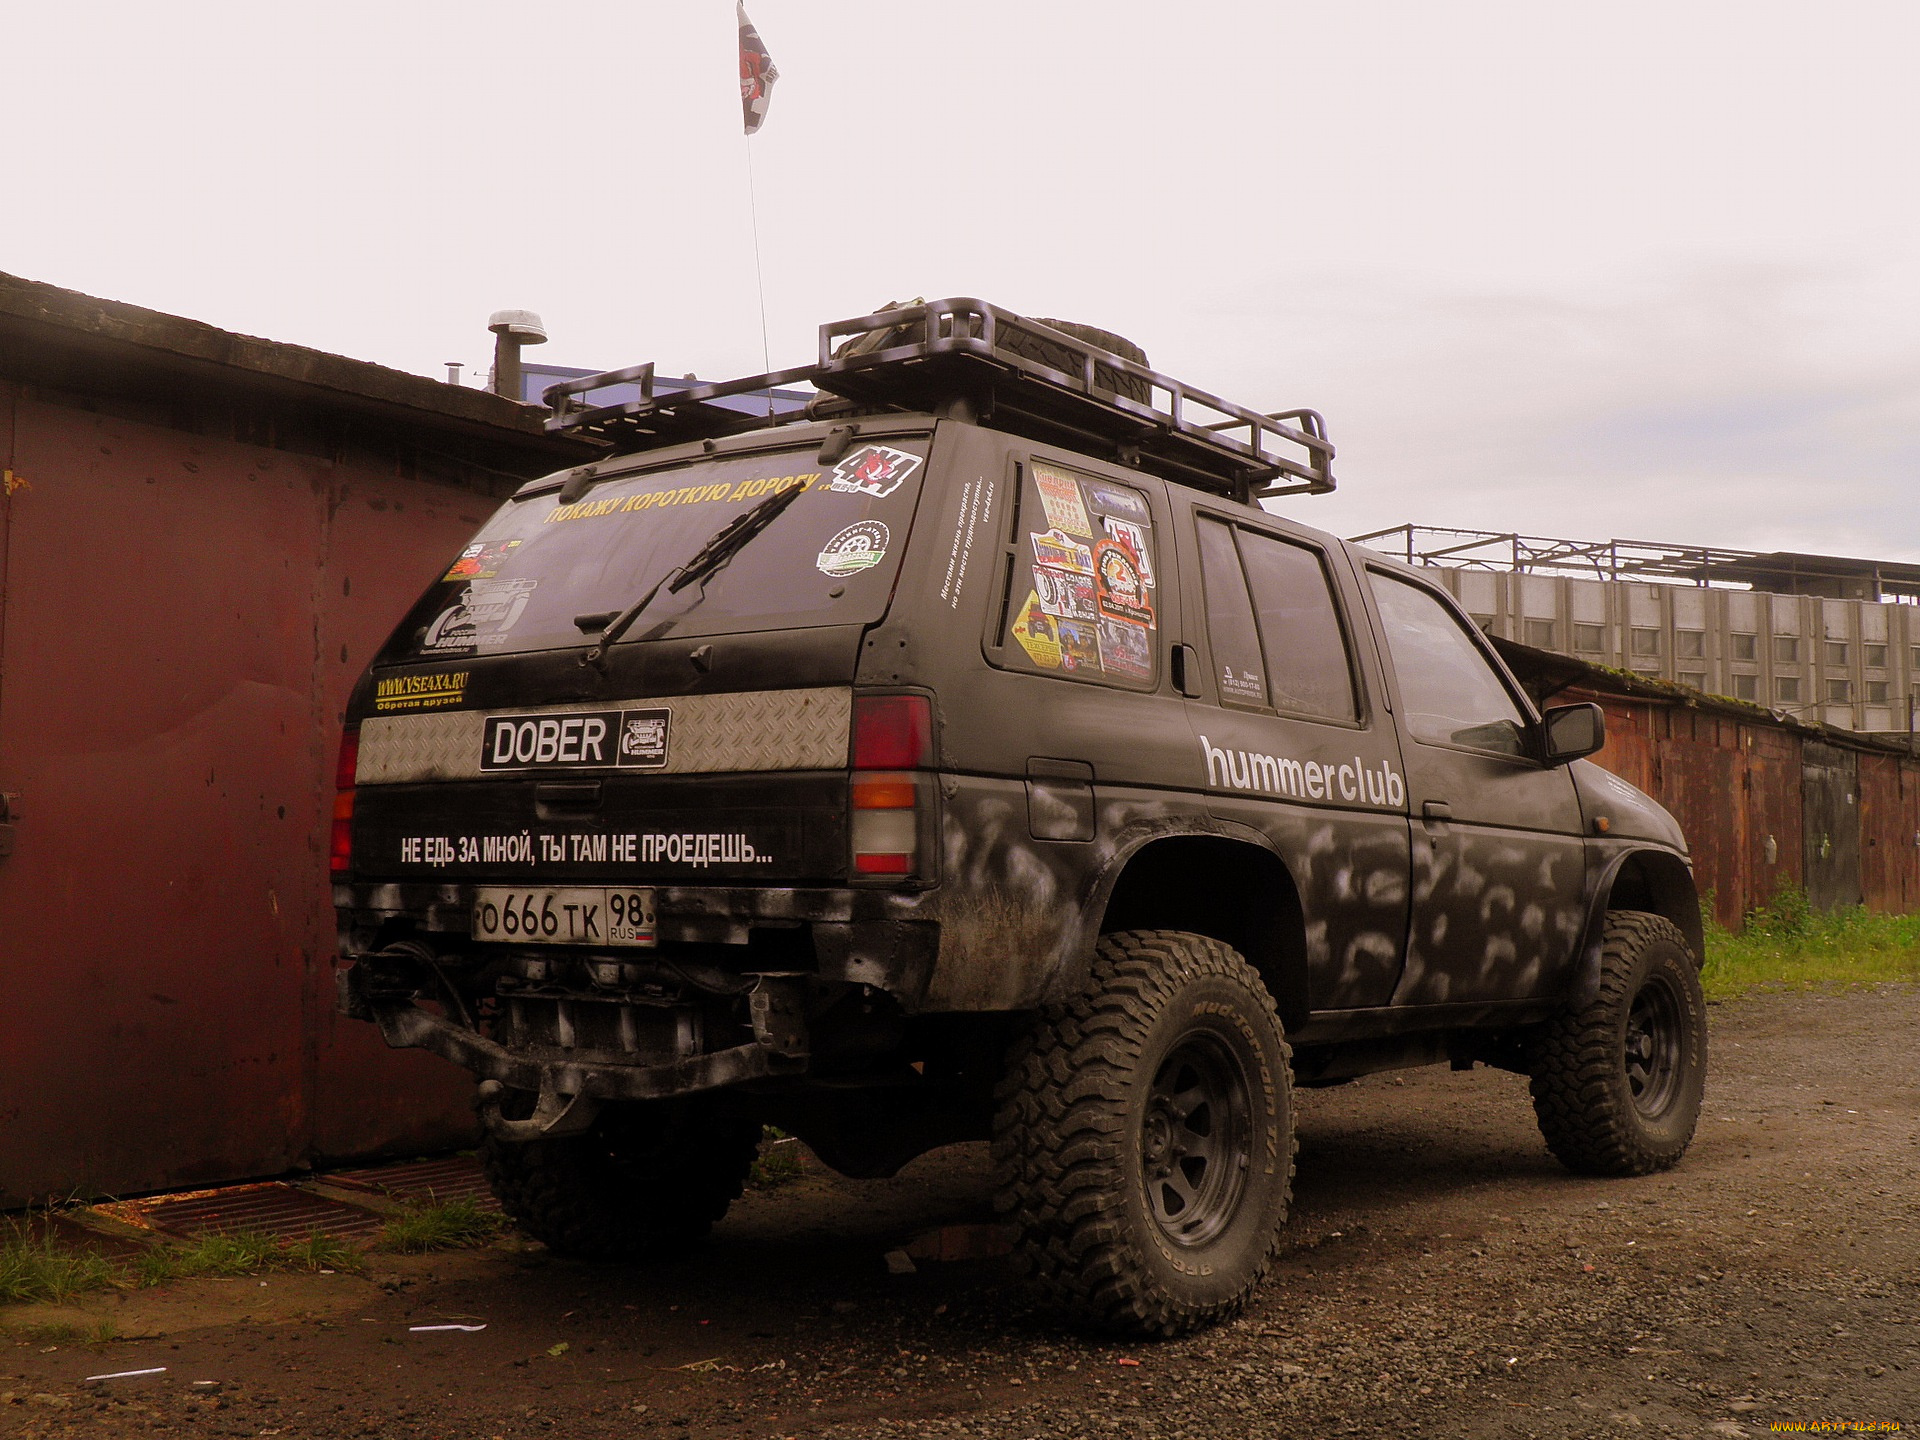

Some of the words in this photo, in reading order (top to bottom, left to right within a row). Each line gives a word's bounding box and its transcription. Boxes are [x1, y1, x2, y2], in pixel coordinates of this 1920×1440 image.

[544, 496, 626, 524] ПОКАЖУ
[621, 482, 731, 513] КОРОТКУЮ
[940, 558, 956, 600] Местами
[951, 529, 962, 558] жизнь
[957, 481, 971, 529] прекрасна,
[951, 596, 958, 609] но
[959, 550, 969, 578] места
[435, 634, 508, 648] HUMMER
[377, 671, 470, 697] WWW.VSE4X4.RU
[377, 700, 420, 710] Обретая
[423, 696, 463, 707] друзей
[493, 718, 607, 763] DOBER
[1200, 735, 1404, 807] hummerclub
[401, 837, 421, 863] НЕ
[424, 837, 455, 868] ЕДЬ
[458, 836, 480, 863] ЗА
[483, 829, 536, 866] МНОЙ,
[539, 835, 566, 862] ТЫ
[570, 834, 607, 862] ТАМ
[612, 834, 637, 862] НЕ
[642, 833, 773, 868] ПРОЕДЕШЬ...
[610, 893, 644, 927] 98
[611, 927, 636, 940] RUS
